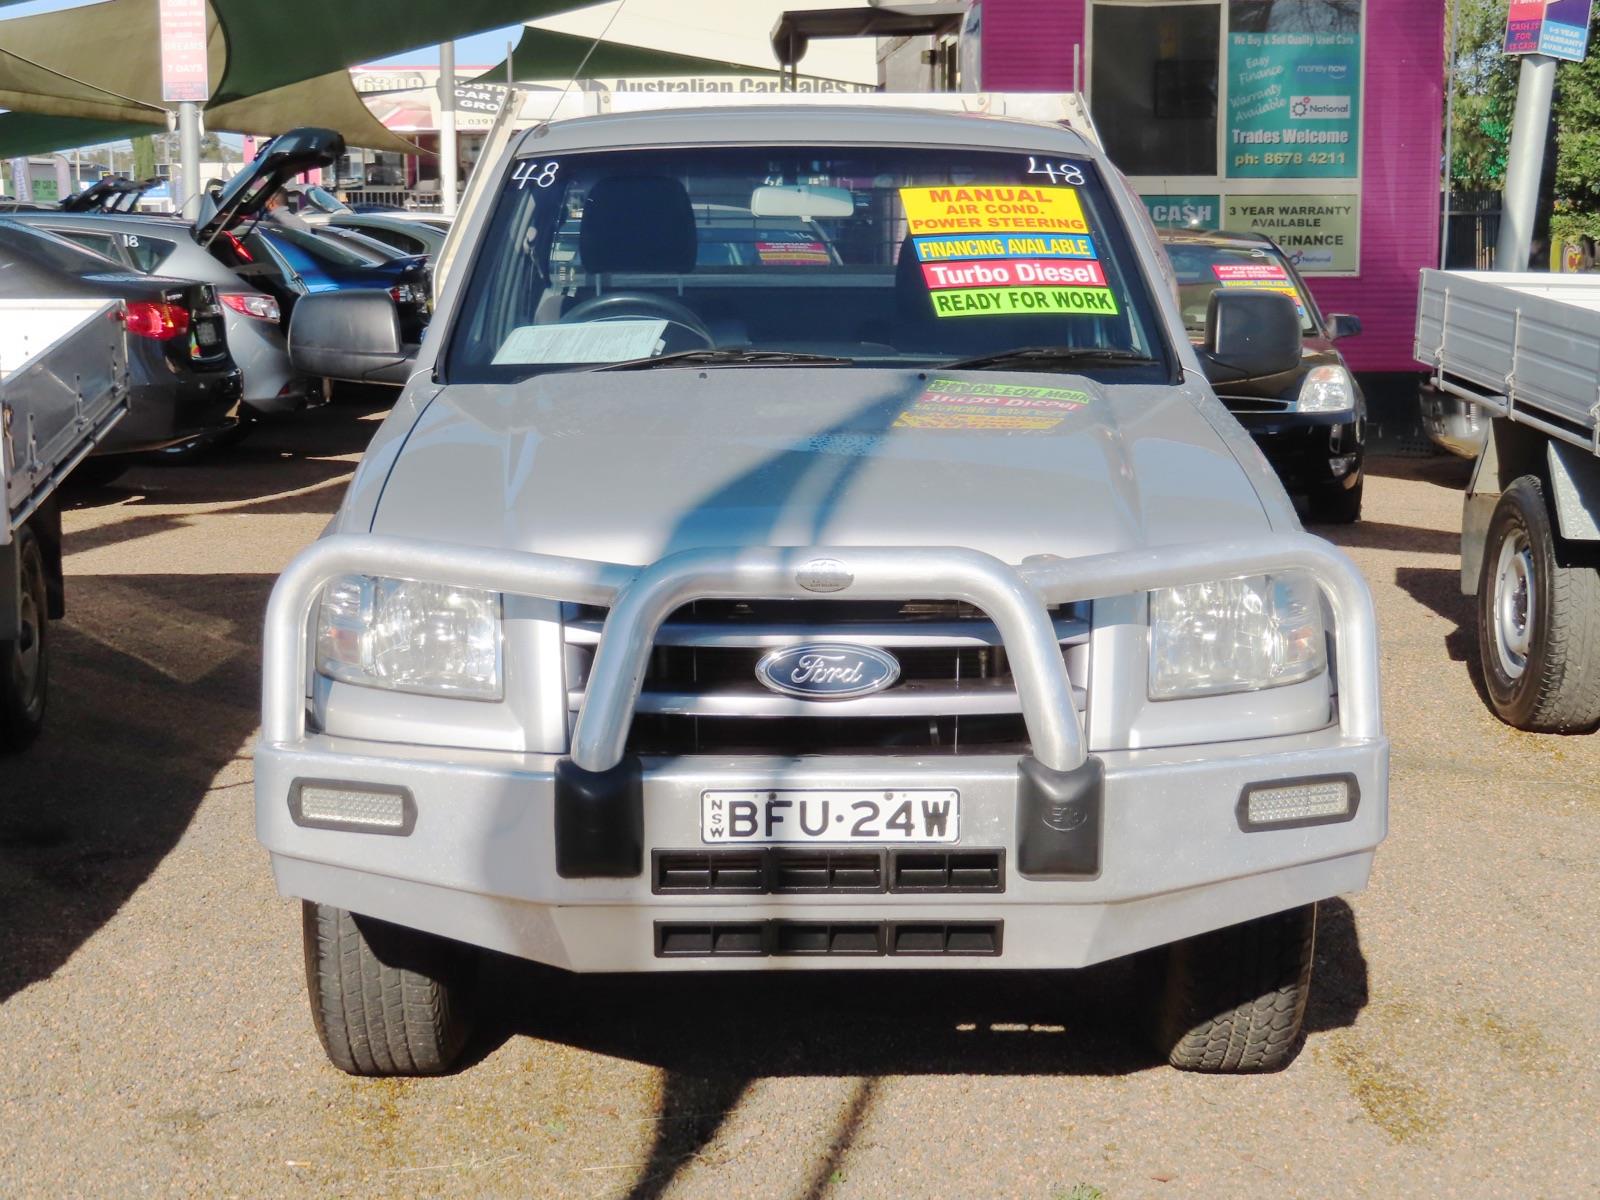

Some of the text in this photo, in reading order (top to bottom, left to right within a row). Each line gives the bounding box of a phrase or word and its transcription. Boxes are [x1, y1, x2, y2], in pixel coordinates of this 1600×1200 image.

[1287, 34, 1314, 47] Quality
[1336, 34, 1354, 45] Cars
[1245, 56, 1269, 69] Easy
[1239, 65, 1284, 85] Finance
[454, 89, 491, 101] CAR
[1230, 84, 1283, 109] Warranty
[1235, 97, 1287, 122] Available
[1309, 104, 1348, 113] National
[1232, 129, 1349, 144] Trades Welcome
[1235, 152, 1345, 167] ph: 8678 4211
[512, 162, 559, 189] 48
[1027, 157, 1085, 186] 48
[929, 190, 1053, 203] MANUAL
[946, 204, 1045, 215] AIR COND.
[1229, 206, 1352, 216] 3 YEAR WARRANTY
[912, 217, 1084, 230] POWER STEERING
[1251, 218, 1321, 228] AVAILABLE
[123, 234, 139, 248] 18
[1278, 235, 1344, 246] FINANCE
[919, 238, 1091, 258] FINANCING AVAILABLE
[930, 263, 1098, 285] Turbo Diesel
[936, 291, 1113, 312] READY FOR WORK
[791, 654, 864, 684] Ford
